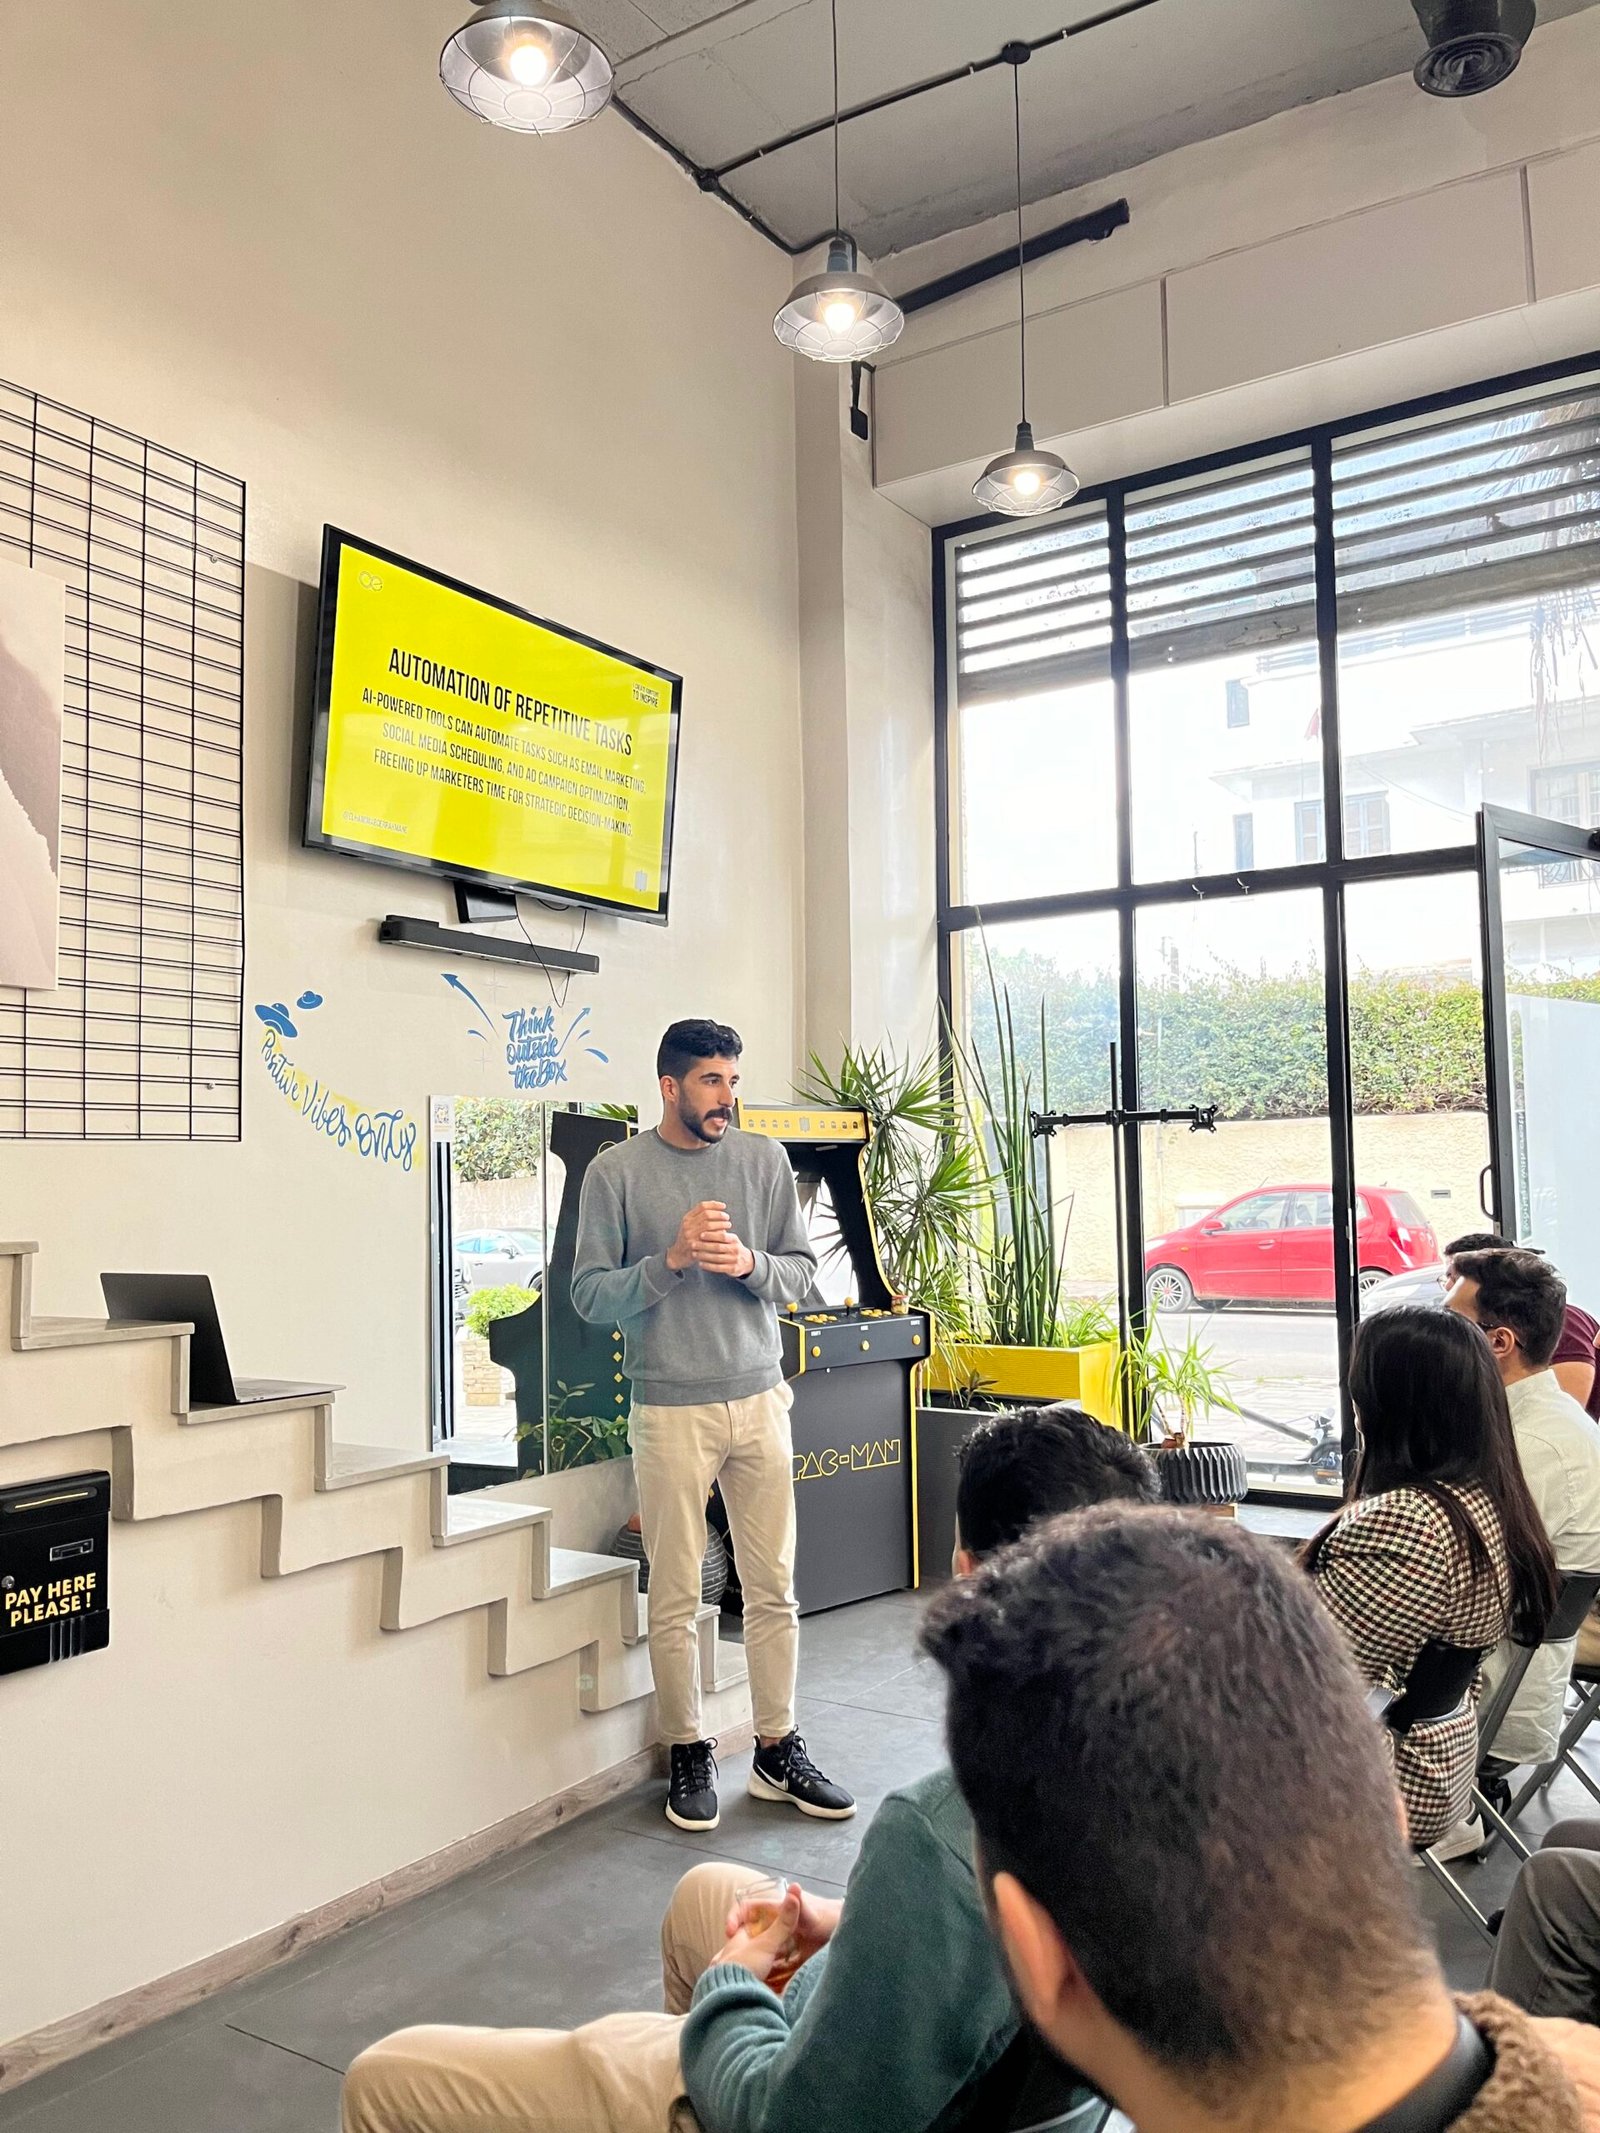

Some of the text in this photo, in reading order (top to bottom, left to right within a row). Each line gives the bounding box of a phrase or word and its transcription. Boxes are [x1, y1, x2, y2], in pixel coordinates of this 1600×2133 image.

[362, 688, 423, 720] AI-POWERED
[425, 708, 453, 731] TOOLS
[455, 718, 473, 736] CAN
[475, 725, 519, 752] AUTOMATE
[521, 740, 545, 760] TASKS
[548, 749, 568, 768] SUCH
[569, 758, 580, 772] AS
[581, 761, 603, 779] EMAIL
[389, 648, 632, 756] AUTOMATION OF REPETITIVE TASKS
[374, 748, 414, 773] FREEING
[416, 760, 429, 777] UP
[431, 765, 484, 793] MARKETERS
[486, 781, 505, 800] TIME
[508, 788, 524, 804] FOR
[525, 793, 567, 817] STRATEGIC
[383, 722, 416, 746] SOCIAL
[418, 734, 447, 755] MEDIA
[507, 762, 524, 779] AND
[526, 768, 537, 783] AD
[539, 771, 578, 796] CAMPAIGN
[502, 1006, 554, 1042] Think
[261, 1029, 300, 1101] Positive
[302, 1080, 351, 1147] Vibes
[793, 1439, 901, 1481] PAC-MAN
[5, 1572, 96, 1610] PAY HERE
[10, 1595, 81, 1627] PLEASE
